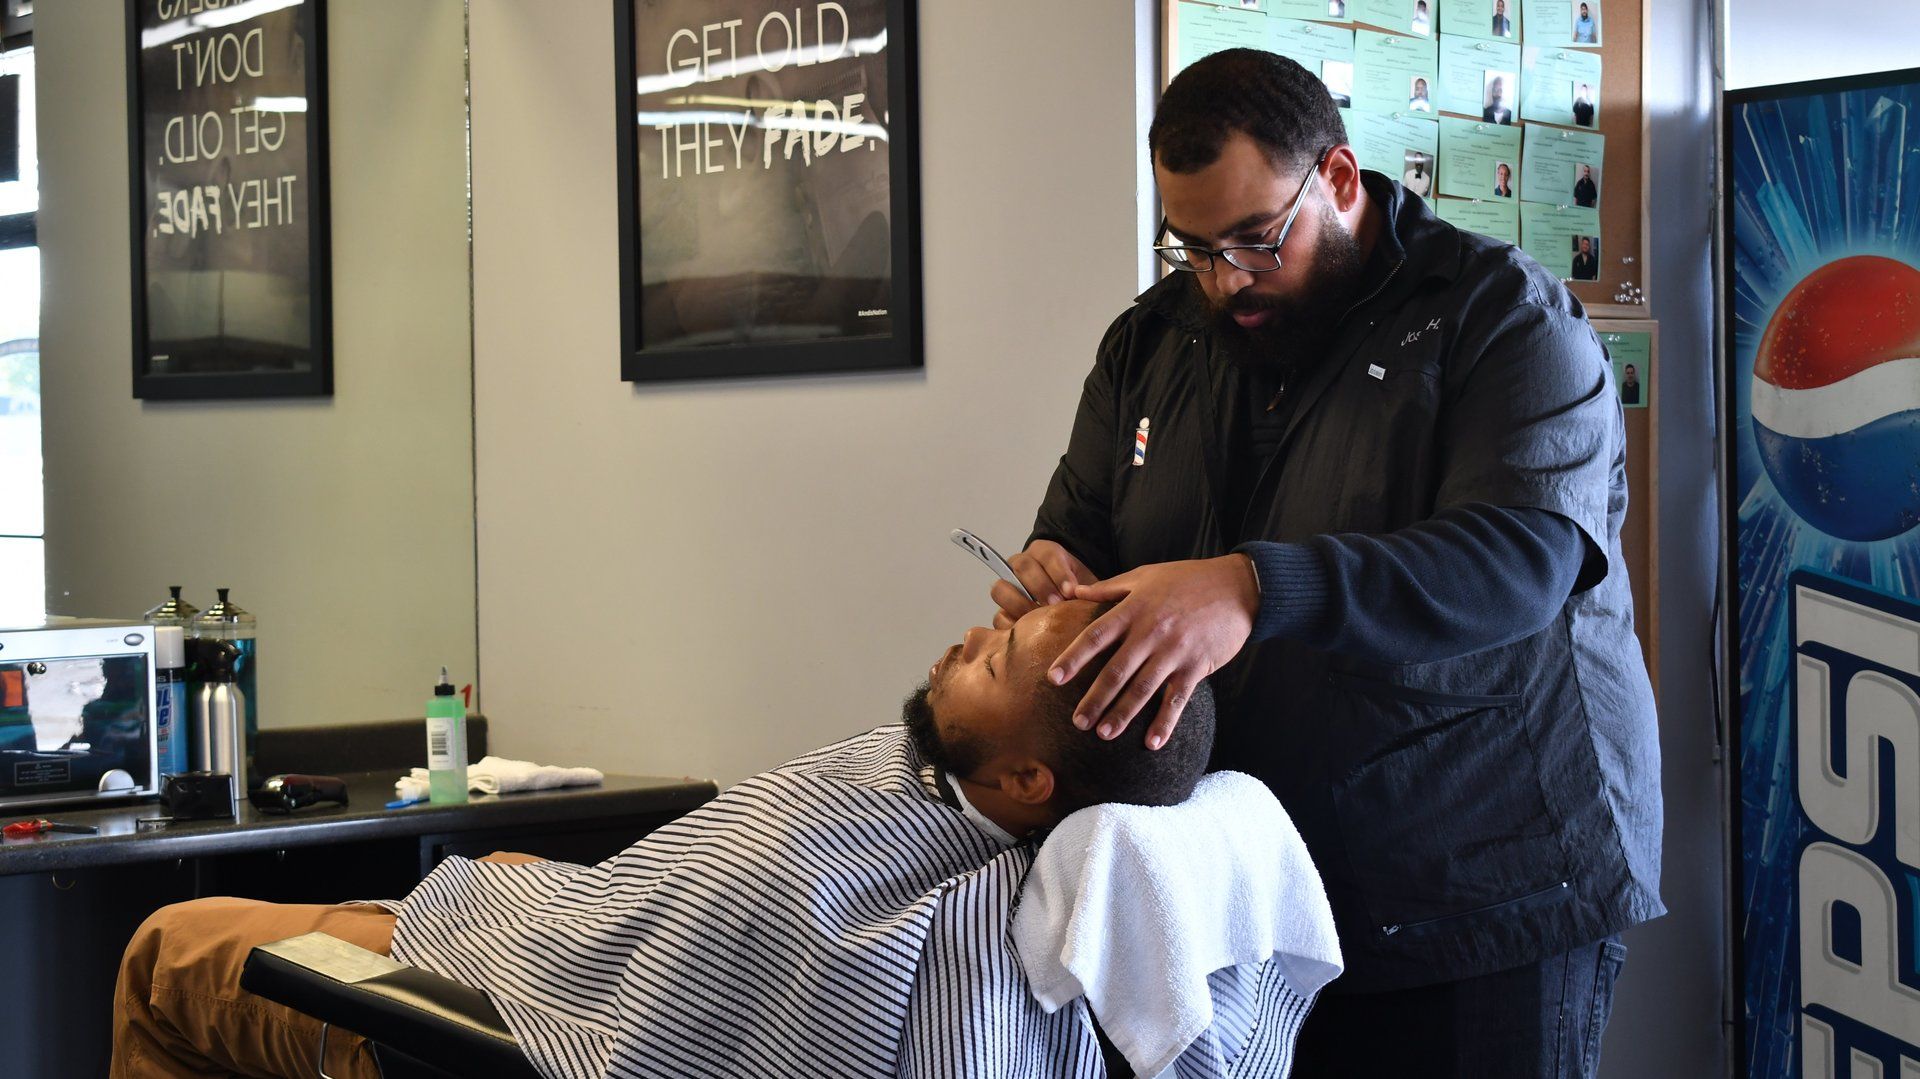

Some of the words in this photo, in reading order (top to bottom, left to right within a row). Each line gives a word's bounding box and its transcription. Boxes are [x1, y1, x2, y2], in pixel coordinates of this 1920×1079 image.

[666, 18, 743, 83] GET
[755, 1, 861, 73] OLD.
[655, 109, 751, 179] THEY
[763, 92, 876, 170] FADE.
